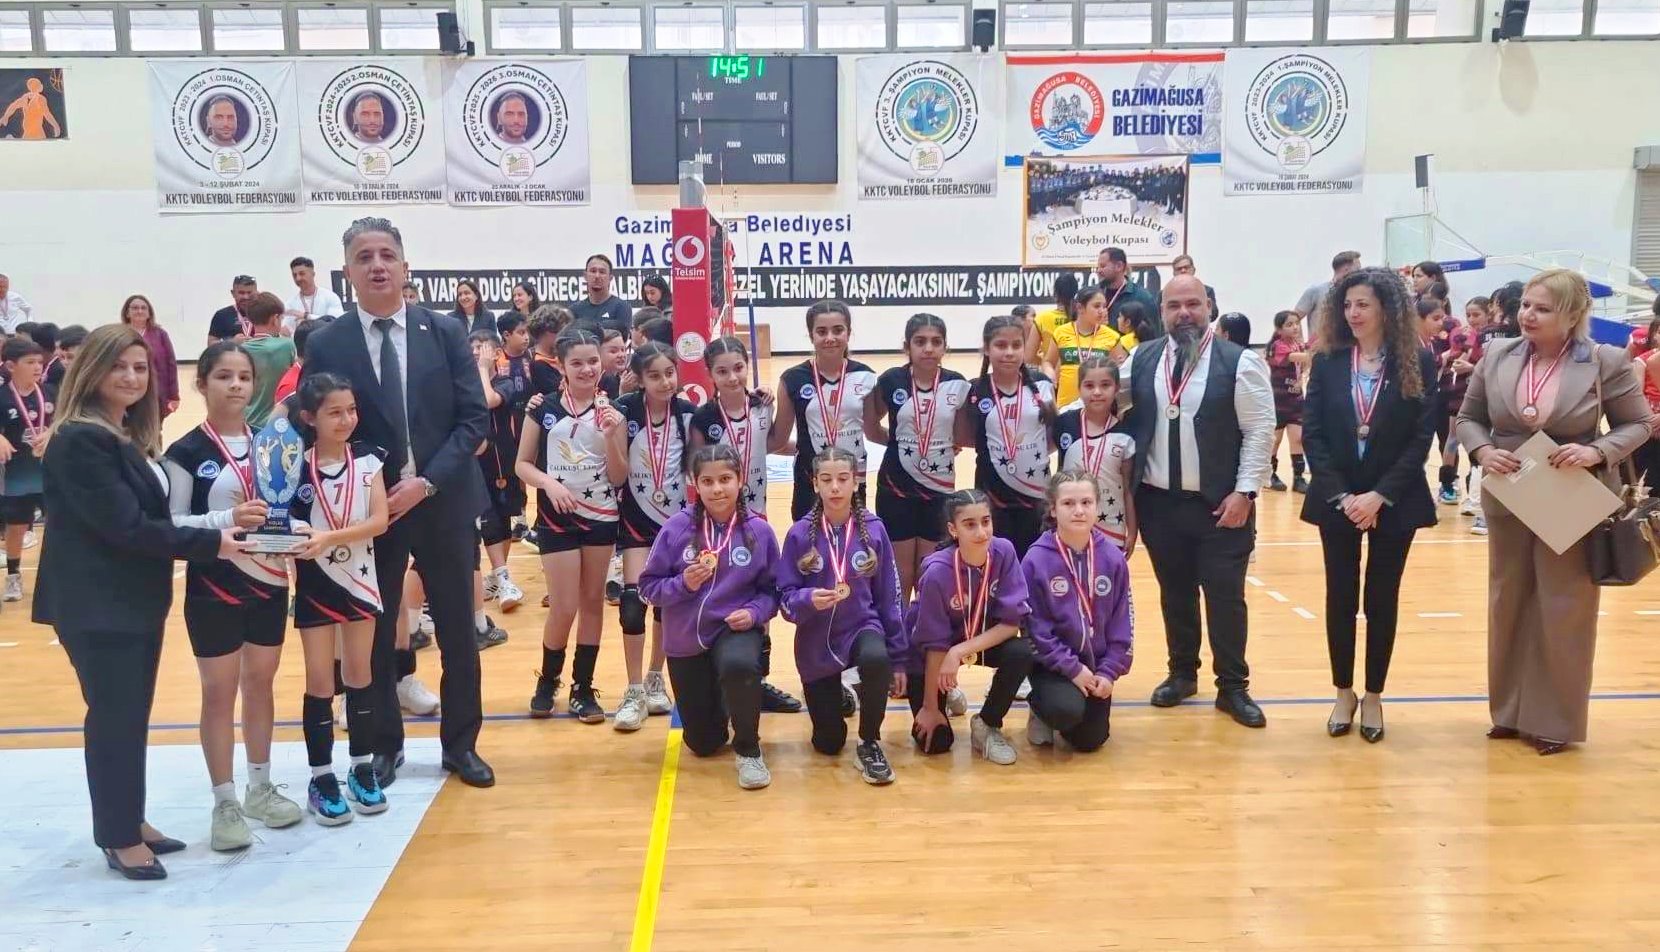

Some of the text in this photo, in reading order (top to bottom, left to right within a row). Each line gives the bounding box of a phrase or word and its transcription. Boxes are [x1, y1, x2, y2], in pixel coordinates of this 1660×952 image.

[711, 56, 764, 78] 14:51
[391, 80, 417, 119] ÇETİNTAŞ
[1033, 76, 1067, 120] GAZİMAĞUSA
[1112, 84, 1204, 107] GAZİMAĞUSA
[1324, 71, 1342, 110] MELEKLER
[470, 115, 485, 148] KKTCVF
[537, 79, 562, 117] ÇETİNTAŞ
[550, 118, 562, 148] KUPASI
[882, 106, 896, 142] KKTCVF
[936, 68, 970, 105] MELEKLER
[178, 116, 192, 147] KKTCVF
[261, 118, 272, 146] KUPASI
[326, 116, 344, 148] KKTCVF
[1112, 109, 1203, 136] BELEDİYESİ
[1252, 113, 1267, 141] KKTCVF
[1324, 112, 1340, 140] KUPASI
[402, 120, 417, 148] KUPASI
[752, 154, 785, 165] VISITORS
[312, 190, 442, 201] KKTC VOLEYBOL FEDERASYONU
[454, 190, 584, 202] KKTC VOLEYBOL FEDERASYONU
[865, 184, 991, 196] KKTC VOLEYBOL FEDERASYONU
[1234, 181, 1352, 191] KKTC VOLEYBOL FEDERASYONU
[166, 192, 296, 205] KKTC VOLEYBOL FEDERASYONU
[1047, 213, 1164, 235] Şampiyon Melekler
[1063, 235, 1149, 247] Voleybol Kupası
[759, 241, 854, 266] ARENA
[675, 267, 705, 277] Telsim
[428, 277, 458, 302] VAR
[770, 269, 835, 298] YERİNDE
[840, 273, 972, 304] YAŞAYACAKSINIZ.
[9, 408, 19, 419] 2
[1005, 404, 1018, 420] 10
[570, 423, 578, 438] 1
[736, 428, 744, 444] 2
